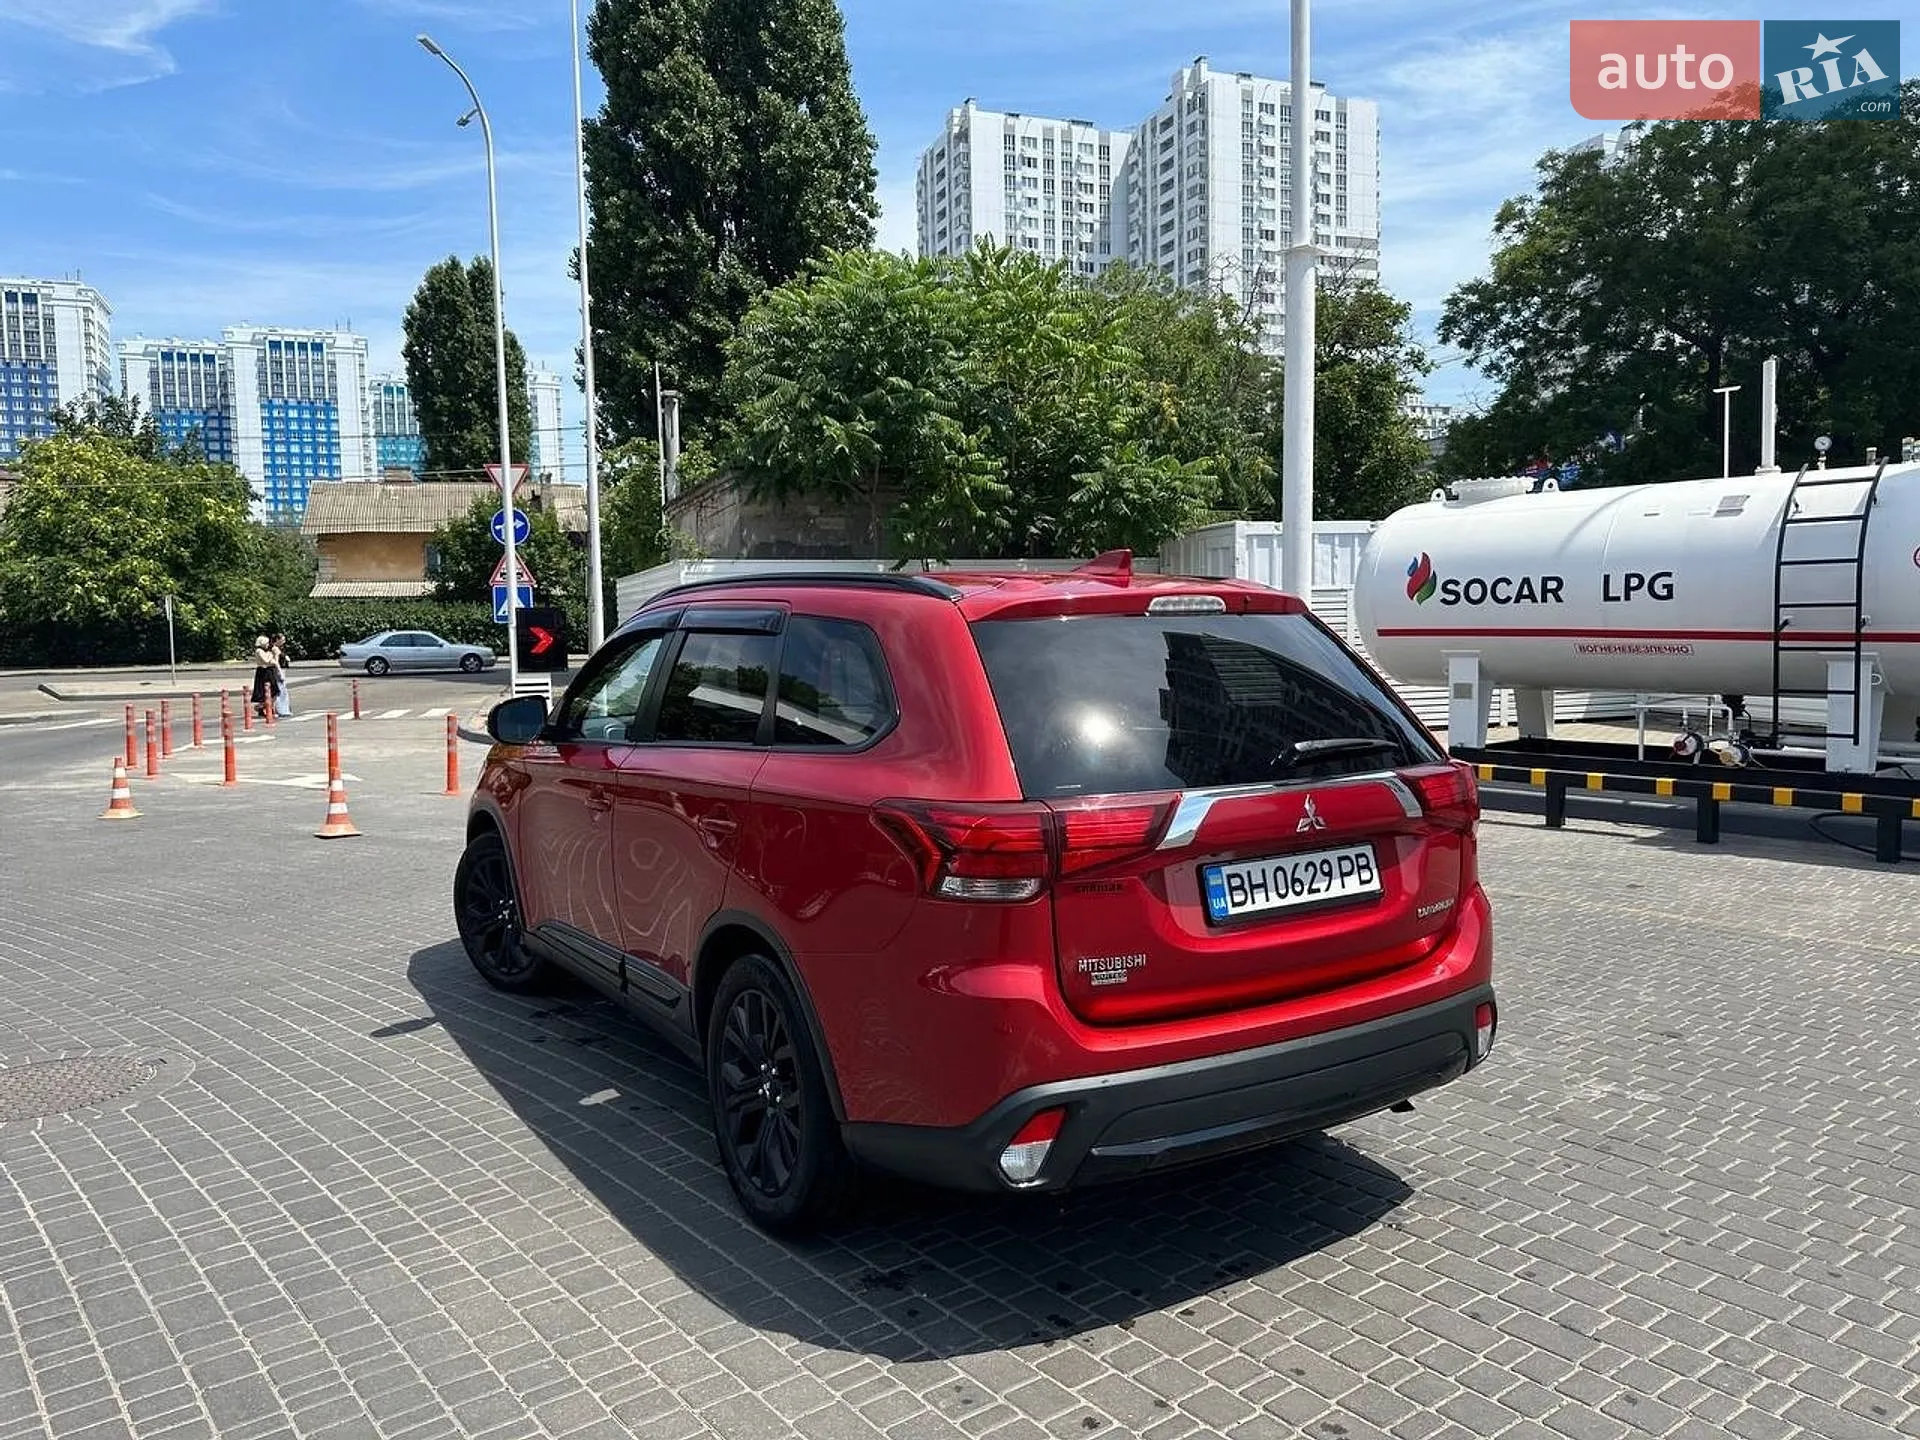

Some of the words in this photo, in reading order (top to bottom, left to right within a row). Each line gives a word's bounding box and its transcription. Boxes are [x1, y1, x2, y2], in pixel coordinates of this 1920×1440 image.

[1440, 575, 1565, 606] SOCAR
[1602, 571, 1674, 602] LPG
[1272, 858, 1333, 900] 0629
[1078, 953, 1147, 973] MITSUBISHI
